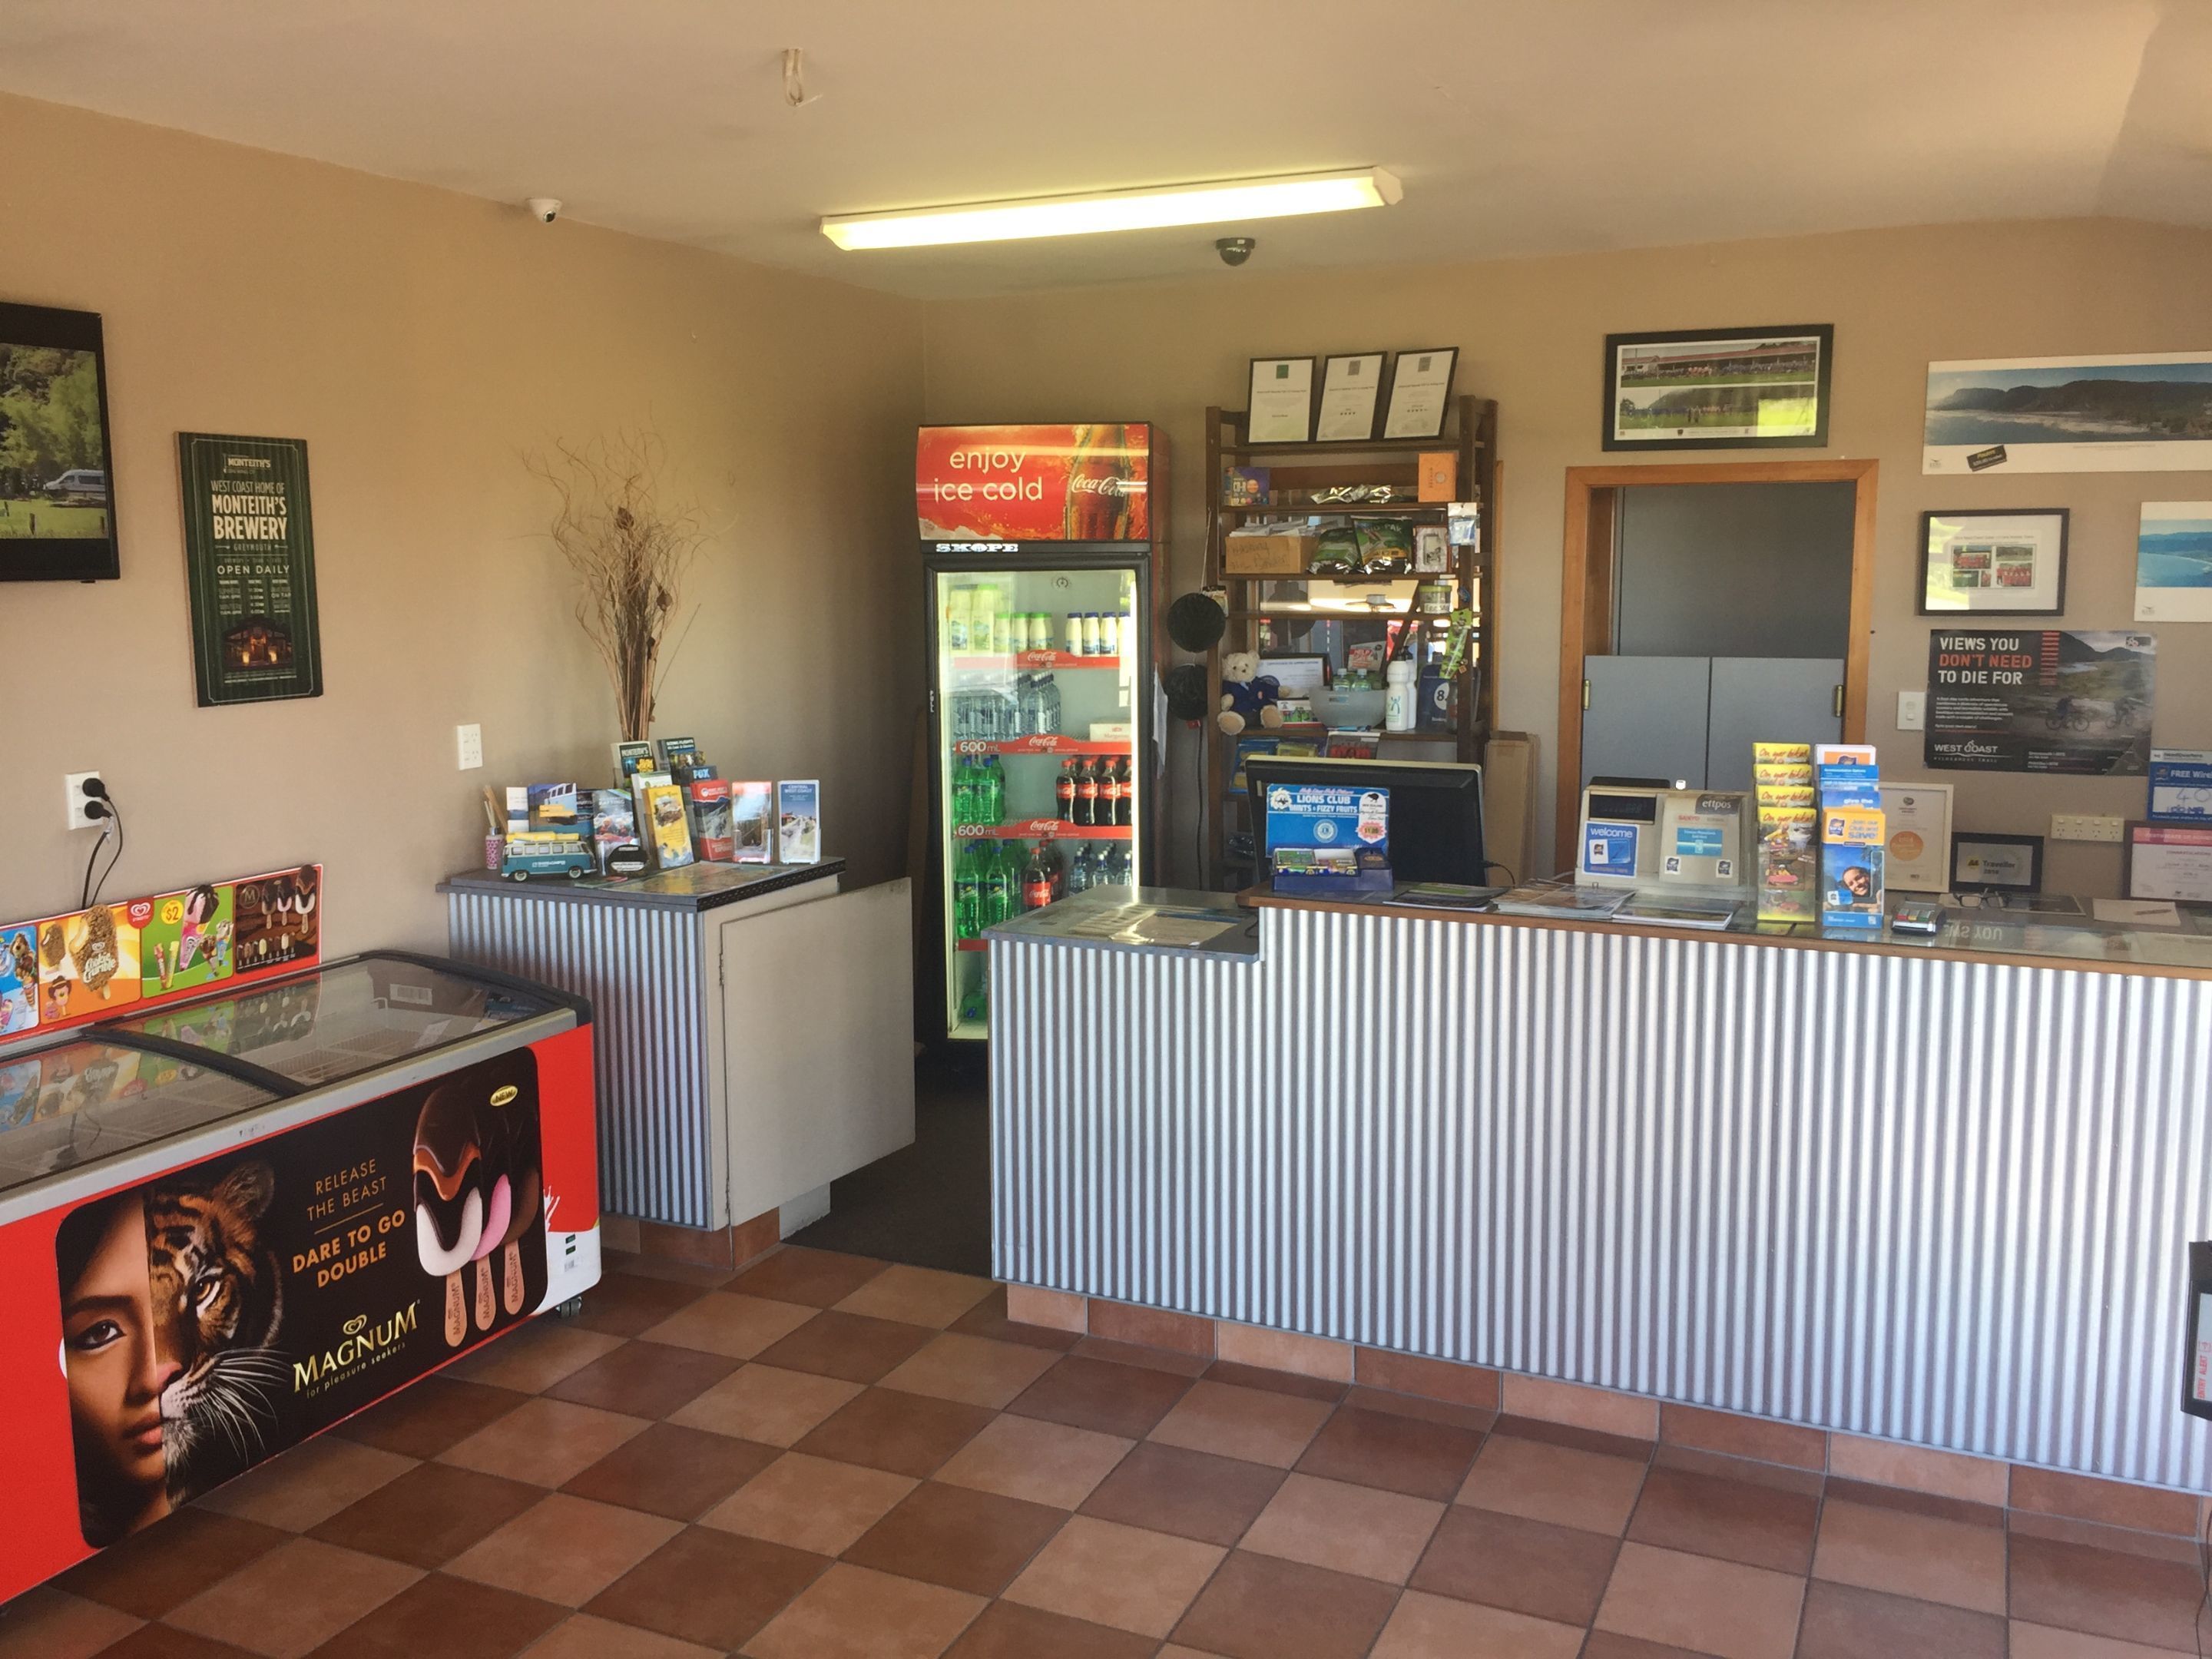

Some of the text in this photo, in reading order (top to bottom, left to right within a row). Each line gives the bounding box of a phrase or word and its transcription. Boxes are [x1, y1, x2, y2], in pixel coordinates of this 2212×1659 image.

[227, 458, 271, 468] MONTEITH'S
[949, 447, 1026, 474] enjoy
[211, 480, 285, 494] WEST COAST HOME OF
[934, 477, 1042, 503] ice cold
[212, 494, 287, 515] MONTEITH'S
[214, 515, 288, 540] BREWERY
[936, 544, 1018, 552] SKOPE
[217, 565, 290, 575] OPEN DAILY
[1940, 637, 2019, 651] VIEWS YOU
[1939, 654, 2032, 667] DON'T NEED
[1938, 670, 2023, 684] TO DIE FOR
[960, 741, 986, 753] 600
[1964, 743, 1998, 753] COAST
[693, 769, 710, 780] FOX
[1296, 795, 1350, 804] LIONS CLUB
[1702, 800, 1731, 810] eftpos
[1290, 804, 1312, 813] MINTS
[958, 825, 984, 836] 600
[1591, 827, 1633, 838] welcome
[245, 889, 256, 900] M
[165, 906, 179, 922] $2
[493, 1090, 515, 1104] NEW
[315, 1158, 376, 1196] RELEASE
[307, 1176, 387, 1221] THE BEAST
[293, 1210, 406, 1273] DARE TO GO
[317, 1241, 387, 1288] DOUBLE
[482, 1270, 490, 1320] MAGNUM
[452, 1284, 462, 1335] MAGNUM
[293, 1301, 418, 1393] MAGNUM
[324, 1362, 367, 1391] pleasure
[371, 1342, 406, 1365] seekers
[2197, 1378, 2207, 1399] ENTRY
